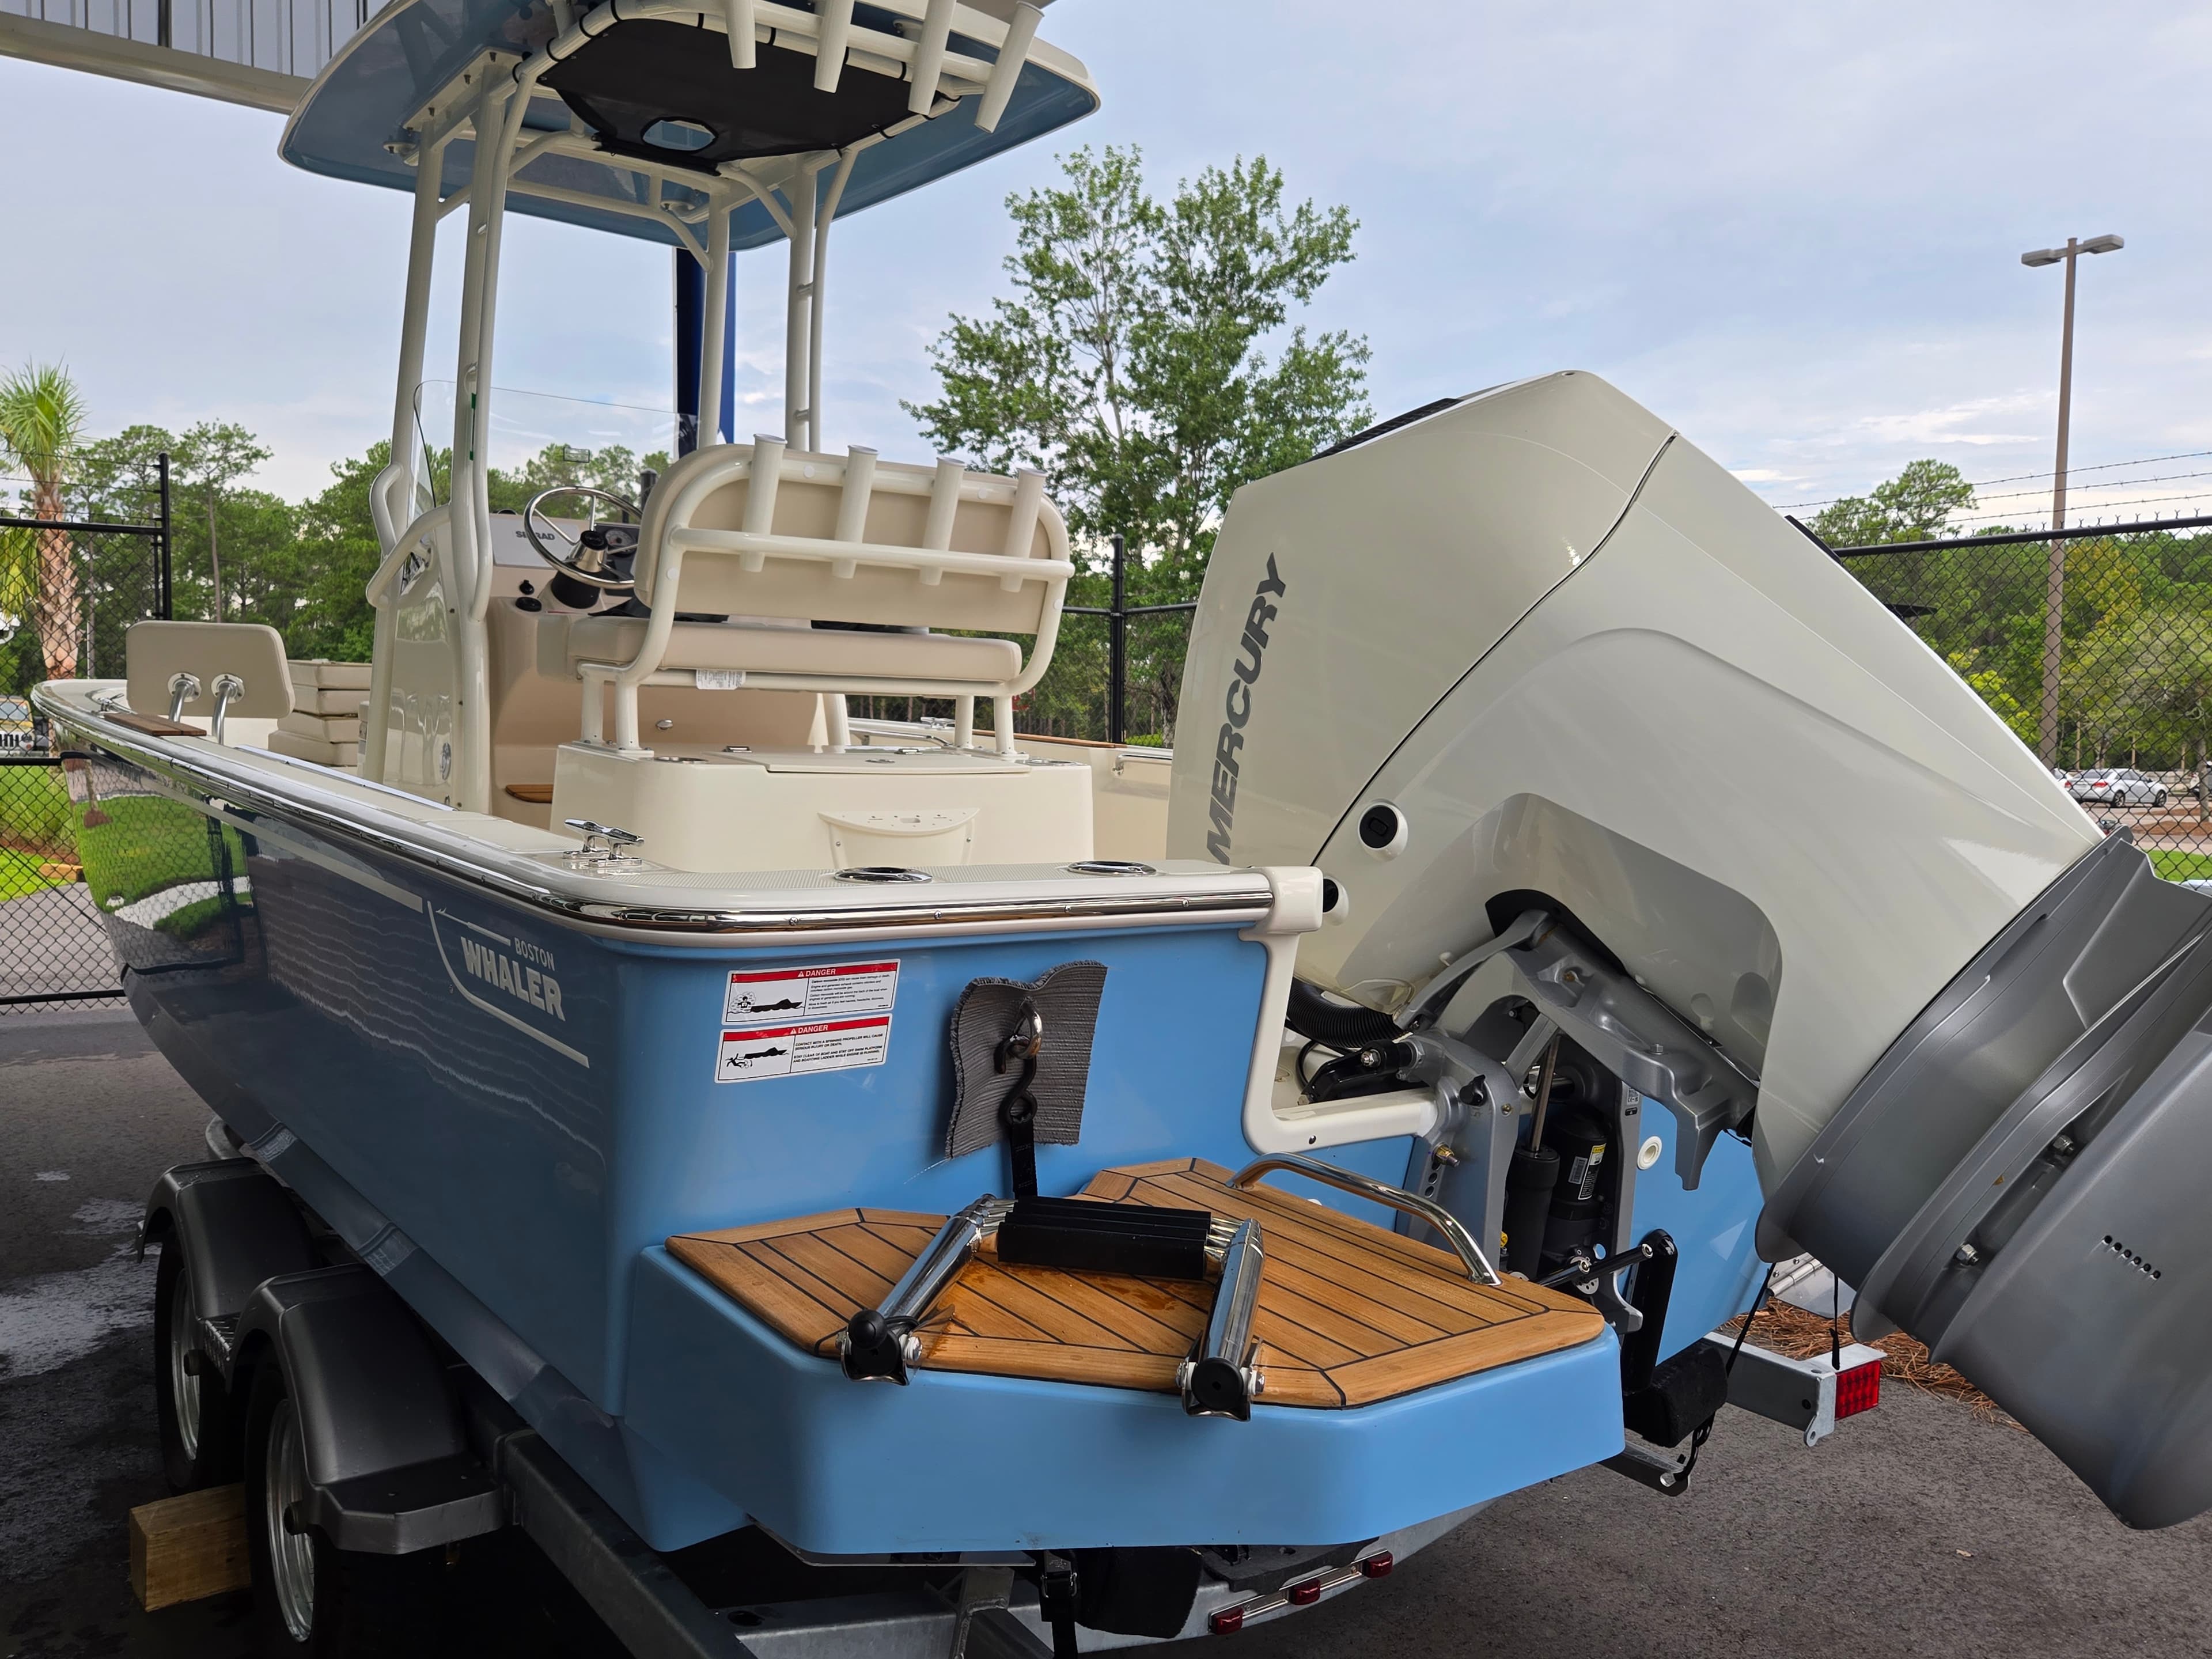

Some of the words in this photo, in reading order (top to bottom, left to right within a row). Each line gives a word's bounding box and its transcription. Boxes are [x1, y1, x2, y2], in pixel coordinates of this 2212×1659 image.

[516, 531, 555, 540] SIRAD
[1206, 552, 1286, 866] MERCURY
[514, 937, 555, 971] BOSTON
[460, 936, 566, 1021] WHALER
[805, 968, 836, 977] DANGER
[798, 1025, 828, 1034] DANGER
